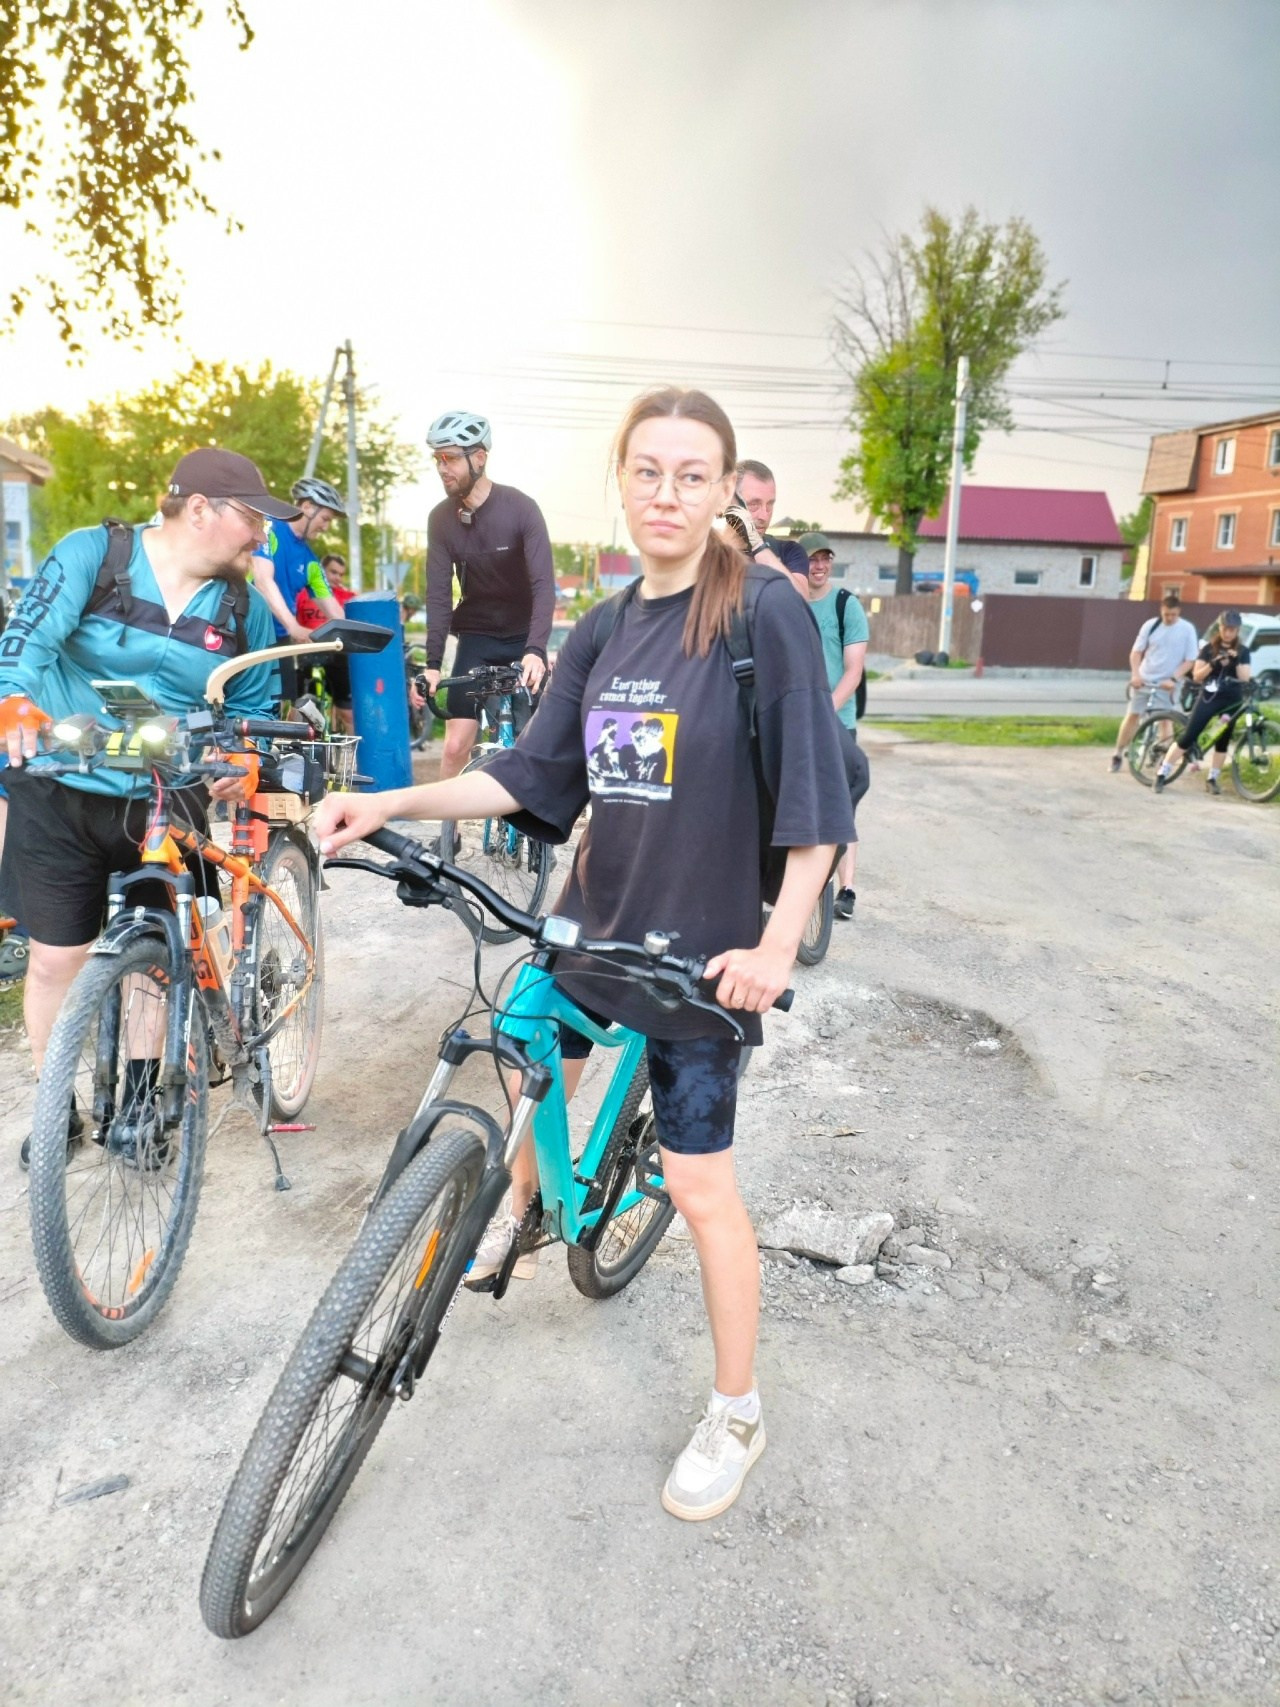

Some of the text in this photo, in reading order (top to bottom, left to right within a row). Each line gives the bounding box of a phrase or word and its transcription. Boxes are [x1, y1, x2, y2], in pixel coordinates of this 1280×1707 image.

[611, 676, 661, 693] Everything
[599, 691, 667, 705] comes together
